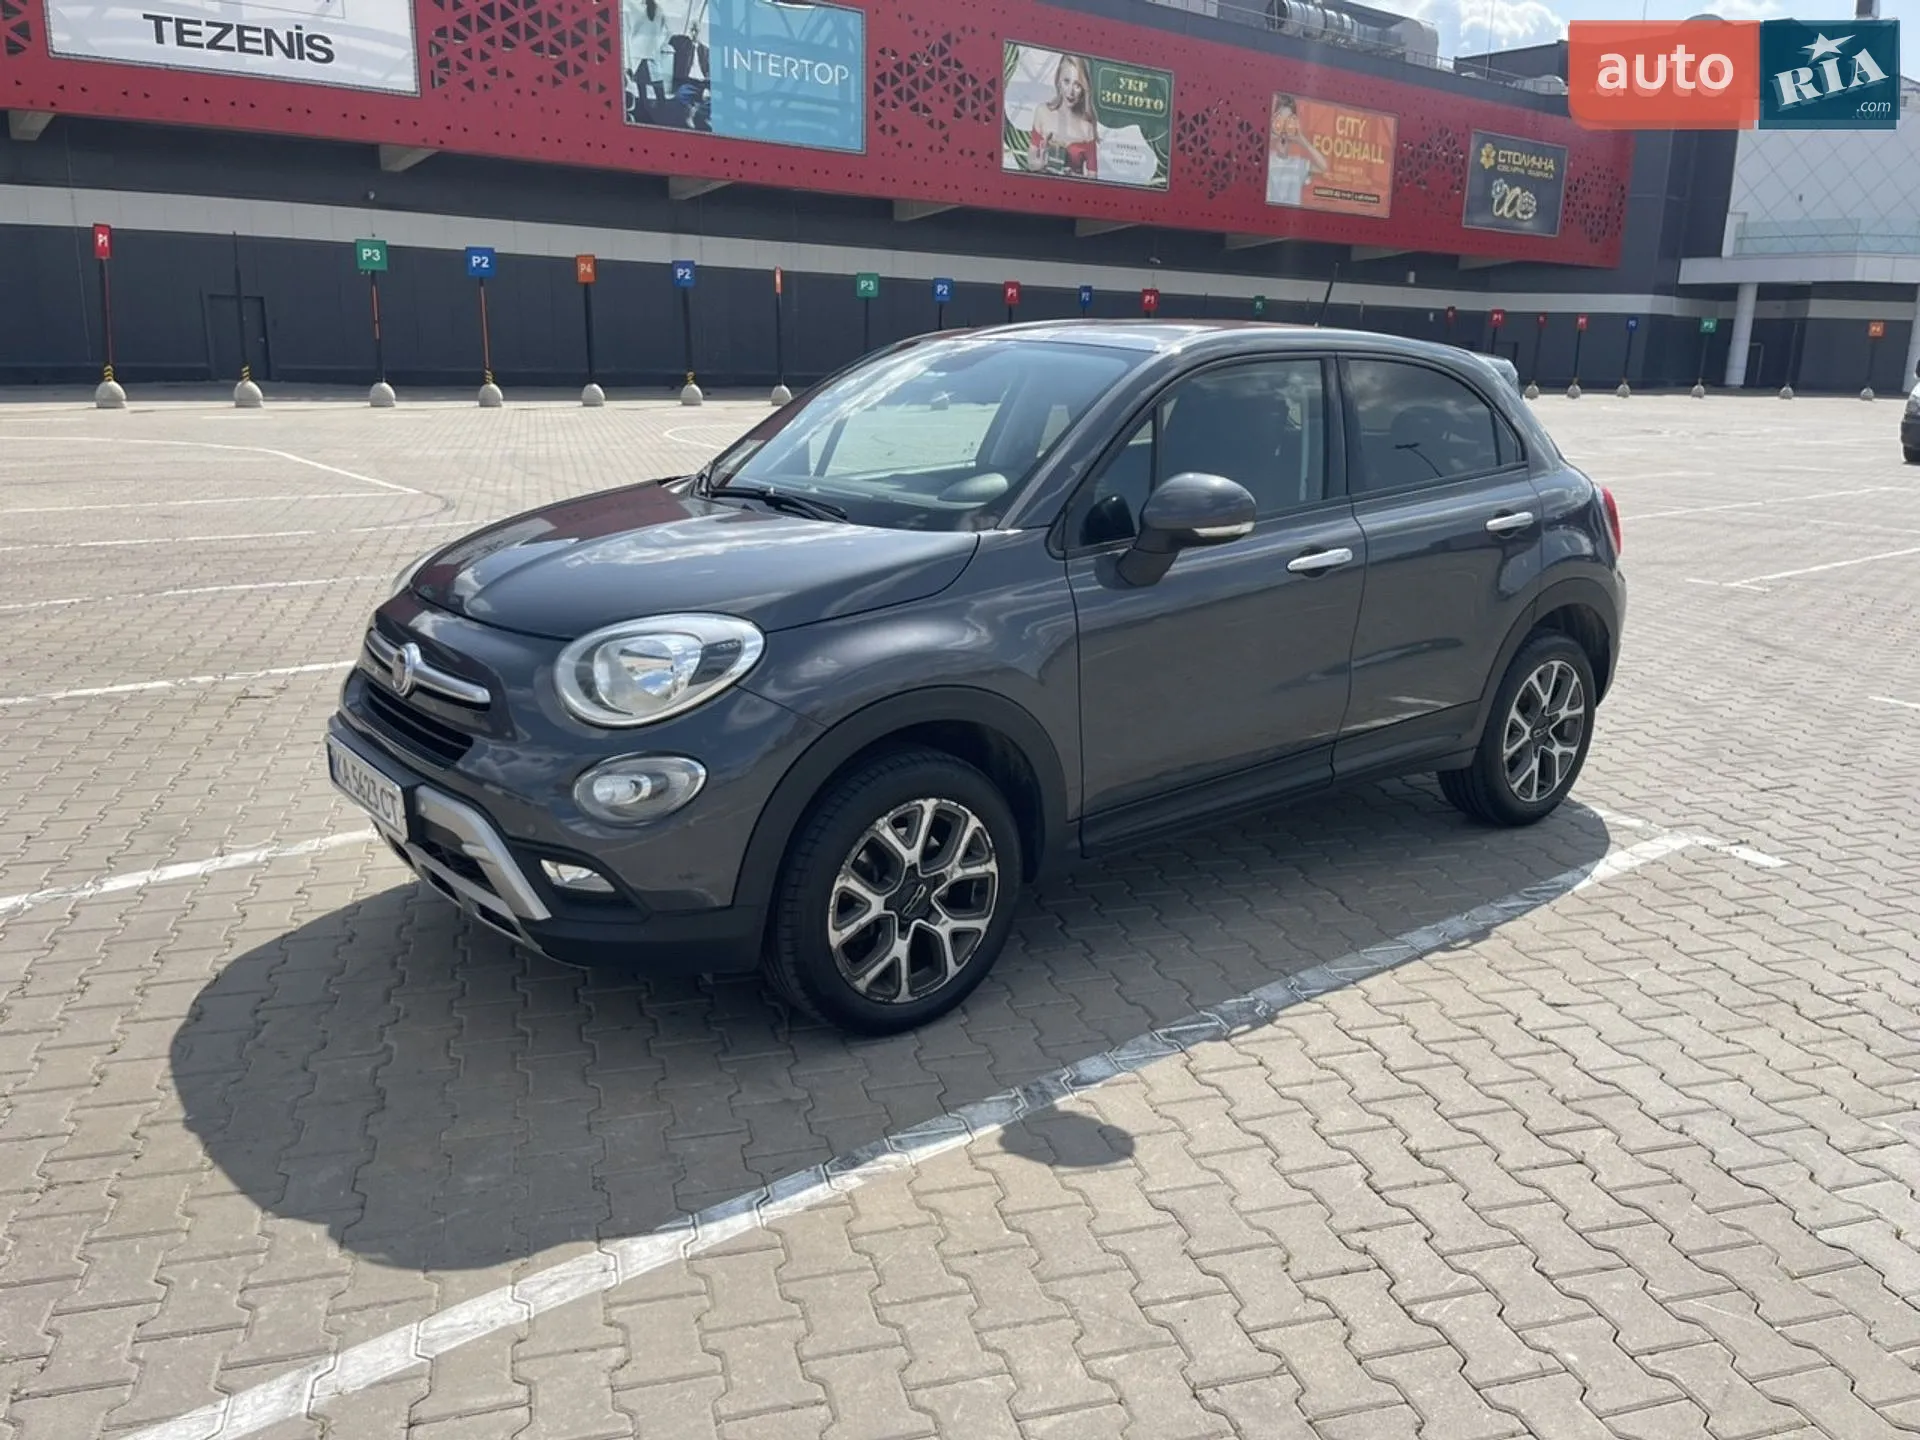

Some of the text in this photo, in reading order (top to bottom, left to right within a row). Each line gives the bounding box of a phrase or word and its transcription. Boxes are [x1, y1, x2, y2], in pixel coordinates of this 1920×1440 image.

[724, 46, 849, 87] INTERTOP
[1119, 76, 1148, 92] УКР
[1101, 90, 1164, 111] ЗОЛОТО
[1336, 115, 1367, 138] CITY
[1313, 134, 1385, 164] FOODHALL
[362, 248, 381, 261] P3
[471, 255, 490, 268] P2
[676, 268, 691, 280] P2
[860, 280, 874, 291] P3
[936, 284, 948, 295] P2
[380, 787, 398, 826] CT
